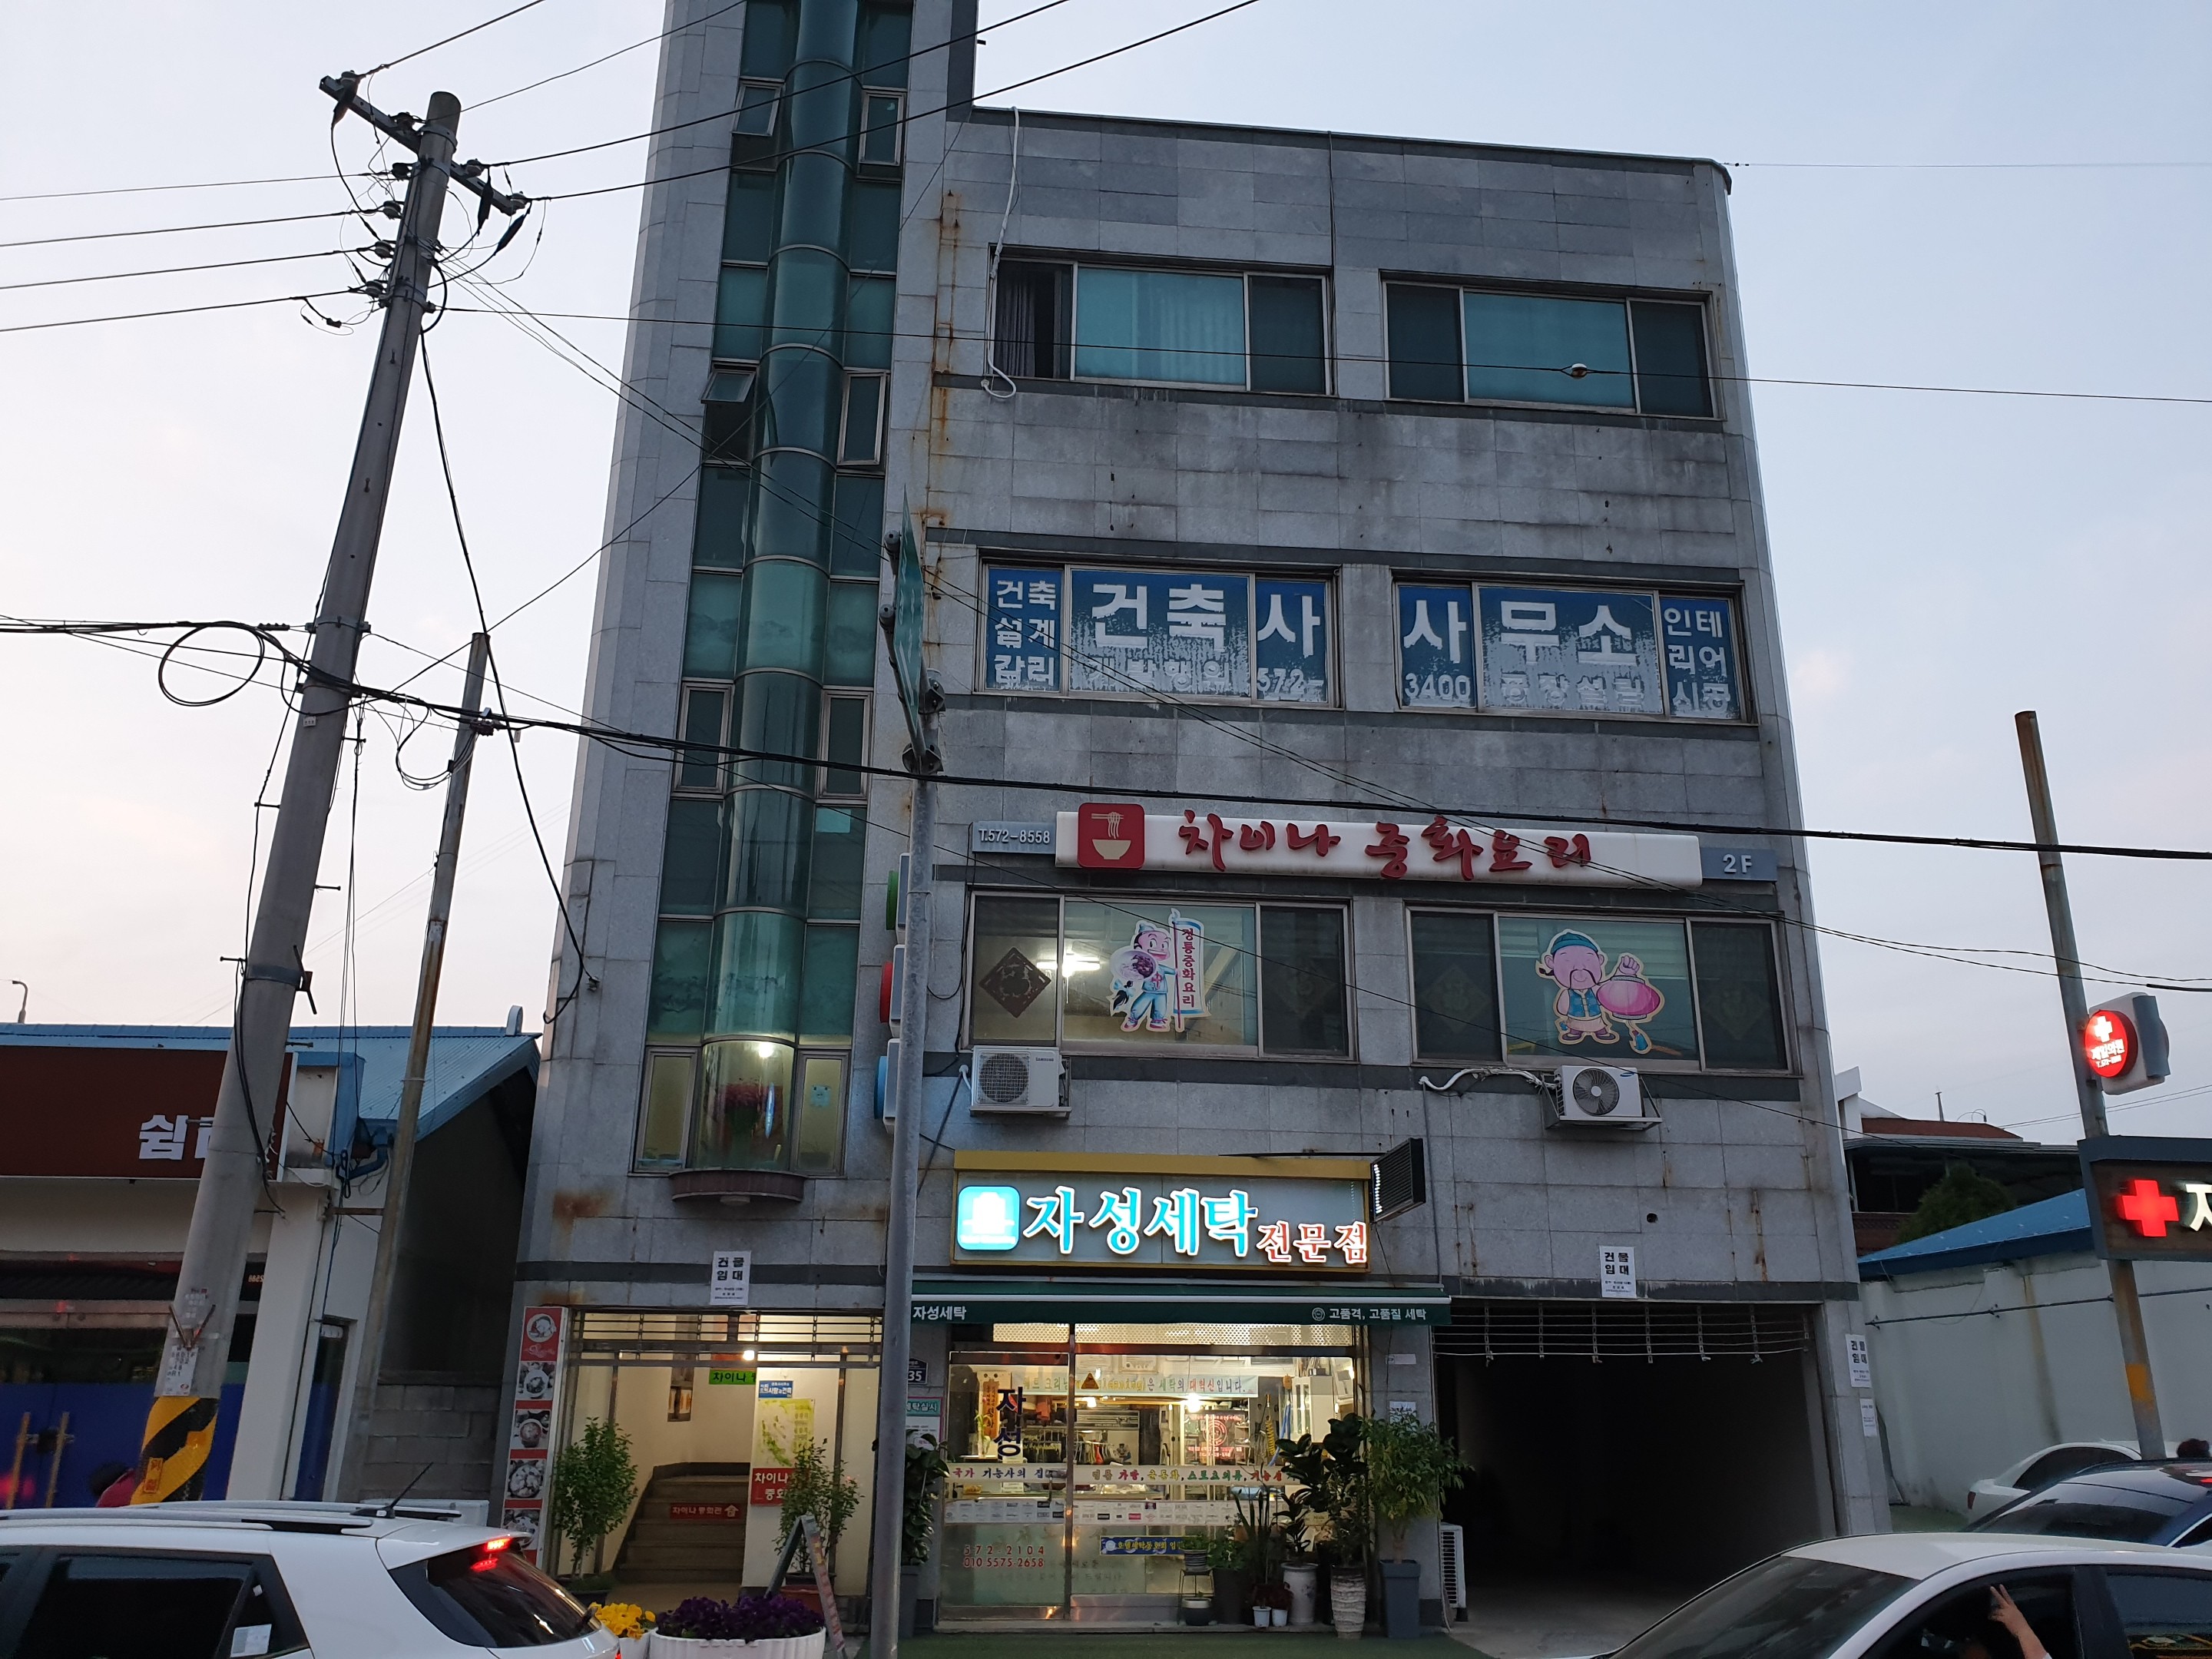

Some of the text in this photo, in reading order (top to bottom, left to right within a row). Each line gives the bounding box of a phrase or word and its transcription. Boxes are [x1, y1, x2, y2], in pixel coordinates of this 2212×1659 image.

[996, 580, 1057, 610] 건축
[1091, 584, 1320, 657] 건축사
[1403, 600, 1639, 667] 사무소
[1405, 673, 1472, 700] 3400
[979, 828, 1051, 844] T.572-8558
[1723, 853, 1753, 875] 2F
[1181, 928, 1196, 1008] 정통중화요리
[1022, 1184, 1367, 1263] 자성세탁 전문점
[717, 1270, 743, 1281] 임대
[1605, 1264, 1629, 1275] 임대
[912, 1306, 967, 1320] 자성세탁
[1369, 1308, 1402, 1321] 고품질
[1405, 1308, 1427, 1320] 세탁
[713, 1372, 746, 1382] 차이나
[1159, 1378, 1185, 1392] 세탁의
[754, 1472, 790, 1485] 차이나
[952, 1468, 975, 1479] 국가
[982, 1468, 1026, 1479] 기능사의
[964, 1545, 1045, 1556] 572-2104
